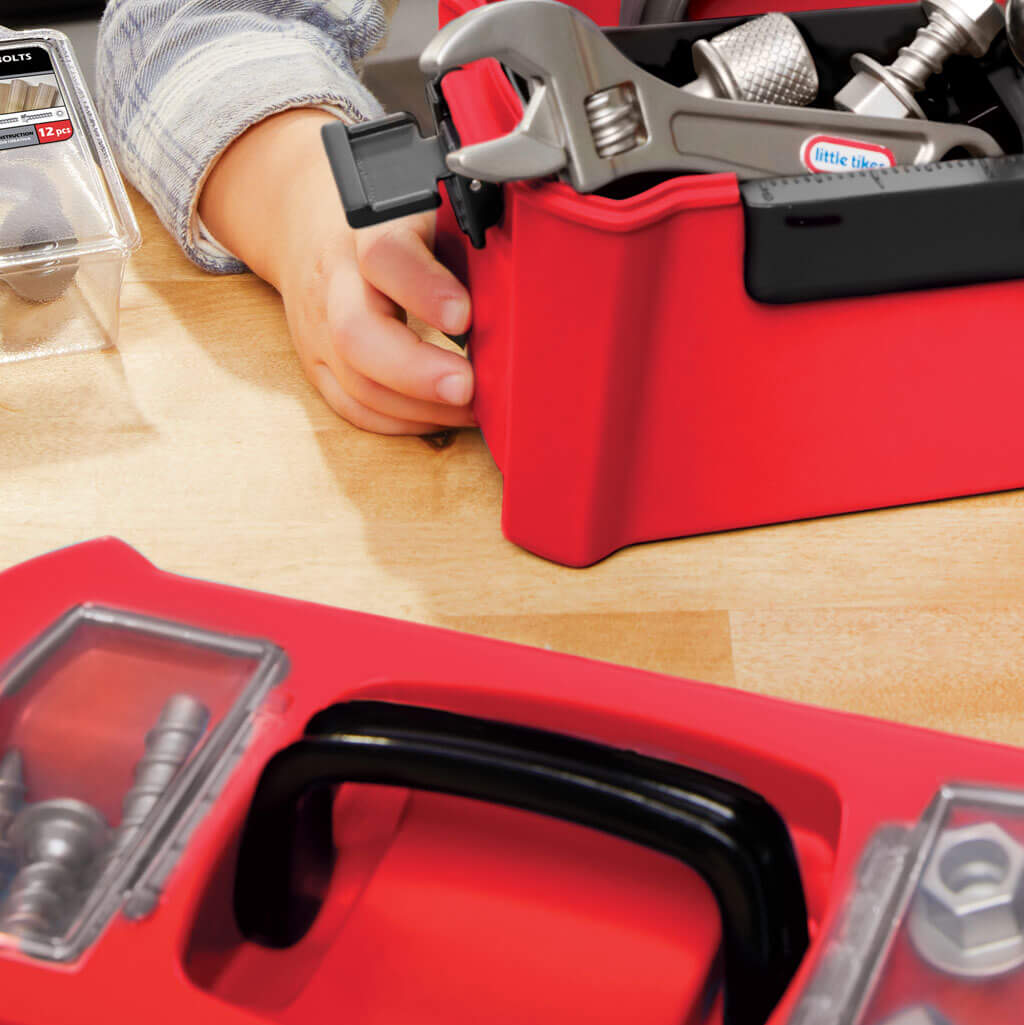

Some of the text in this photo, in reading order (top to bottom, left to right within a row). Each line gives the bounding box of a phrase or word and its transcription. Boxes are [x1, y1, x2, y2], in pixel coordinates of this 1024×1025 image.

[0, 52, 32, 63] OLTS
[38, 126, 71, 138] 12 pcs
[815, 147, 849, 167] little
